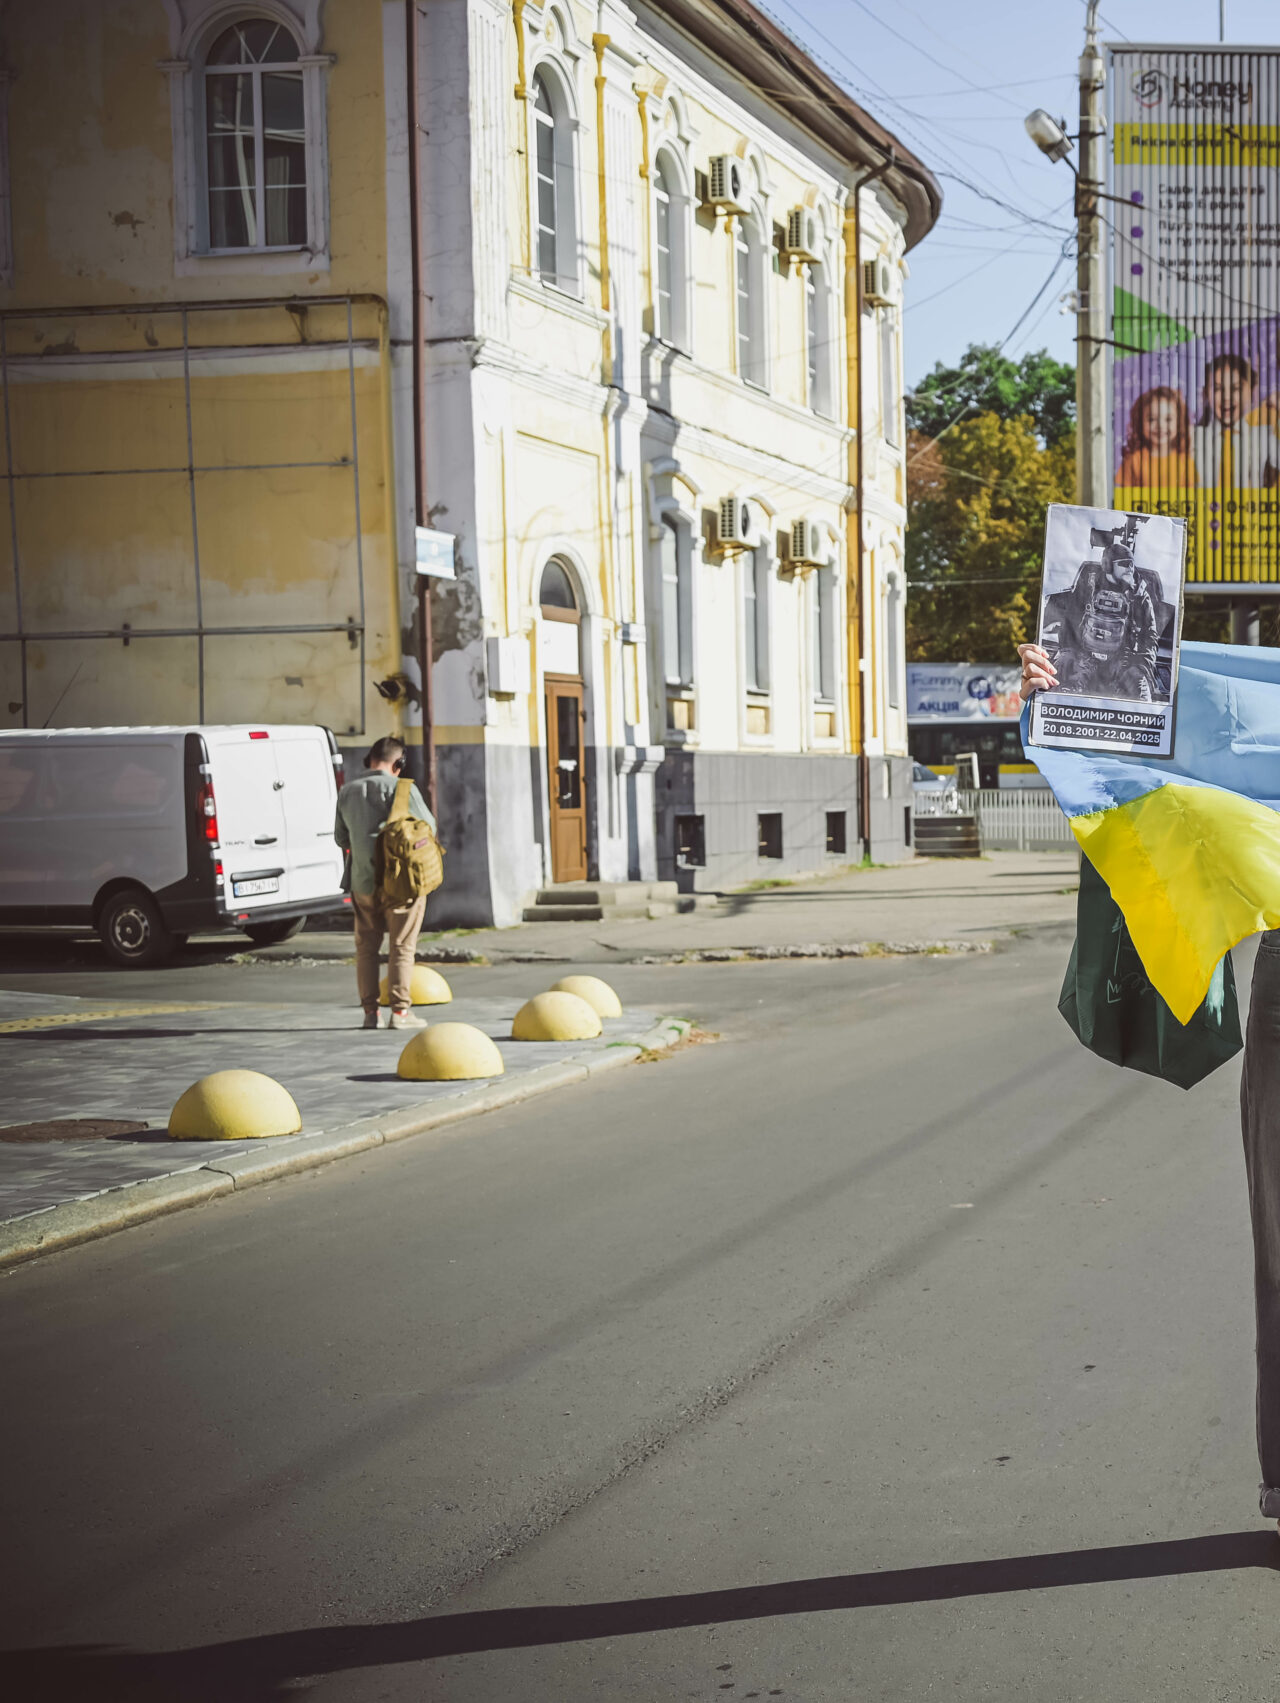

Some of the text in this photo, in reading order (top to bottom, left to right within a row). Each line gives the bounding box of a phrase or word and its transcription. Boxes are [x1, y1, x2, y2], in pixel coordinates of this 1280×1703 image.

[1173, 76, 1253, 105] Honey
[917, 701, 960, 713] АКЦІЯ
[1041, 705, 1165, 727] ВОЛОДИМИР ЧОРНИЙ
[1043, 723, 1160, 743] 20.08.2001-22.04.2025
